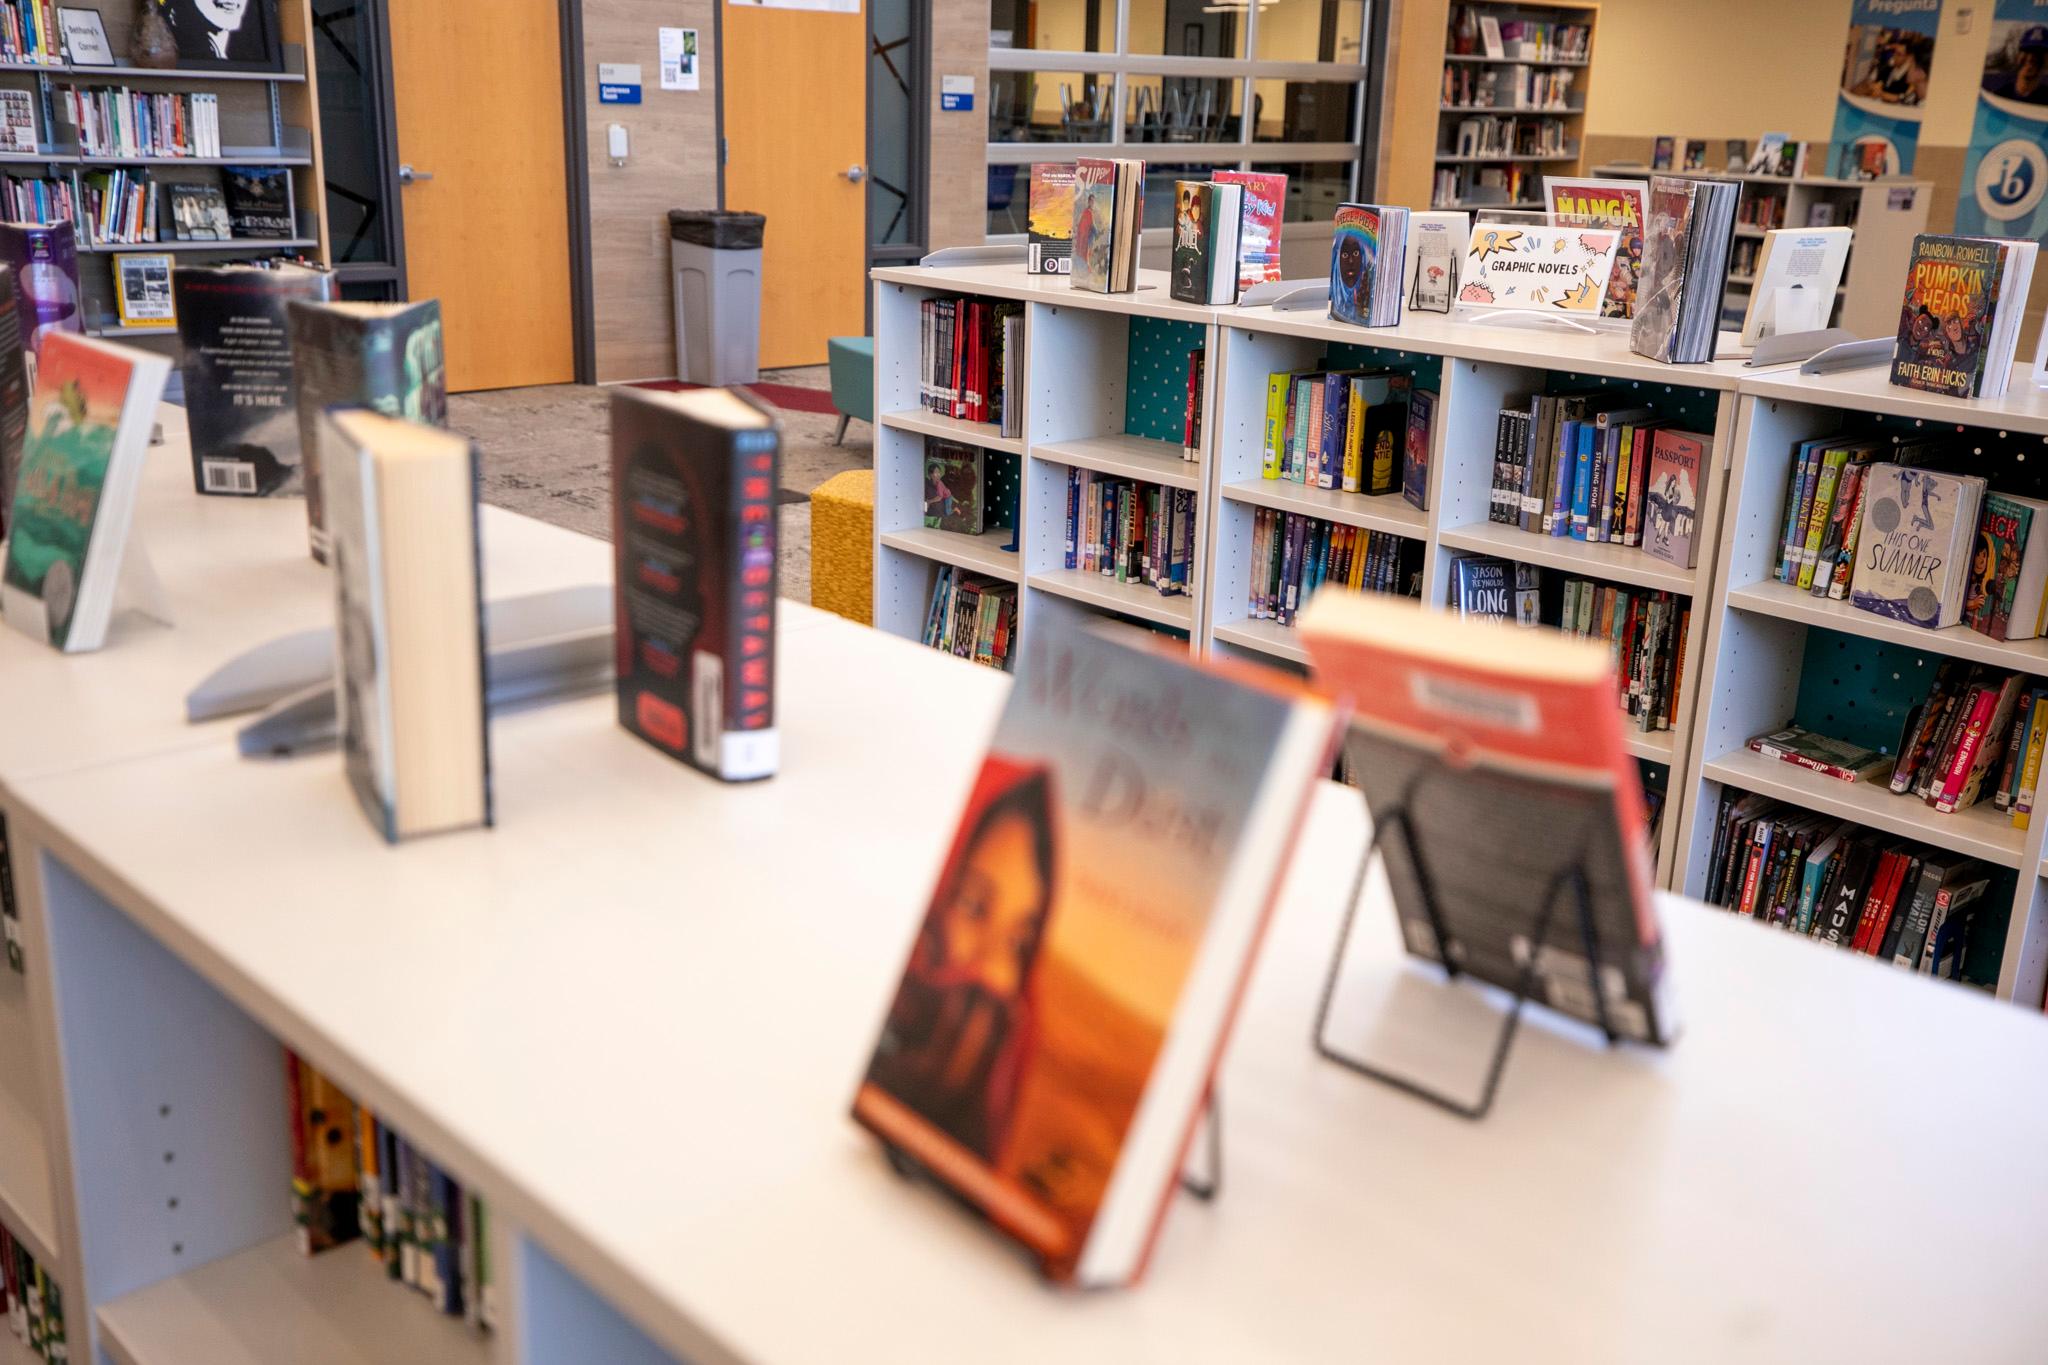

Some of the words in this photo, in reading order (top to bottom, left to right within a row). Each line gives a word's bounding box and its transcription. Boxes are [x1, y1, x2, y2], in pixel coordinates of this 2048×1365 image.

[1256, 199, 1276, 216] Kid
[1556, 196, 1639, 228] MANGA
[1336, 212, 1352, 224] PIECE
[1358, 214, 1378, 232] PIECE
[1919, 242, 1954, 258] RAINBOW
[1956, 246, 1990, 264] ROWELL
[1492, 260, 1535, 272] GRAPHIC
[1538, 262, 1578, 274] NOVELS
[1915, 264, 1986, 295] PUMPKIN
[1923, 288, 1970, 318] HEADS
[1898, 361, 1921, 379] FAITH
[1922, 366, 1940, 382] ERIN
[1942, 370, 1967, 388] HICKS
[1593, 452, 1602, 484] STEALING
[1654, 447, 1696, 470] PASSPORT
[1883, 530, 1904, 546] THIS
[1907, 535, 1930, 552] ONE
[1472, 566, 1503, 578] JASON
[1866, 544, 1942, 585] SUMMER
[1472, 579, 1504, 588] REYNOLDS
[1468, 588, 1508, 614] LONG
[1954, 750, 1968, 776] ENOUGH
[1827, 885, 1856, 942] MAUS
[1871, 899, 1881, 919] MAUS
[1905, 892, 1924, 930] TWAIN
